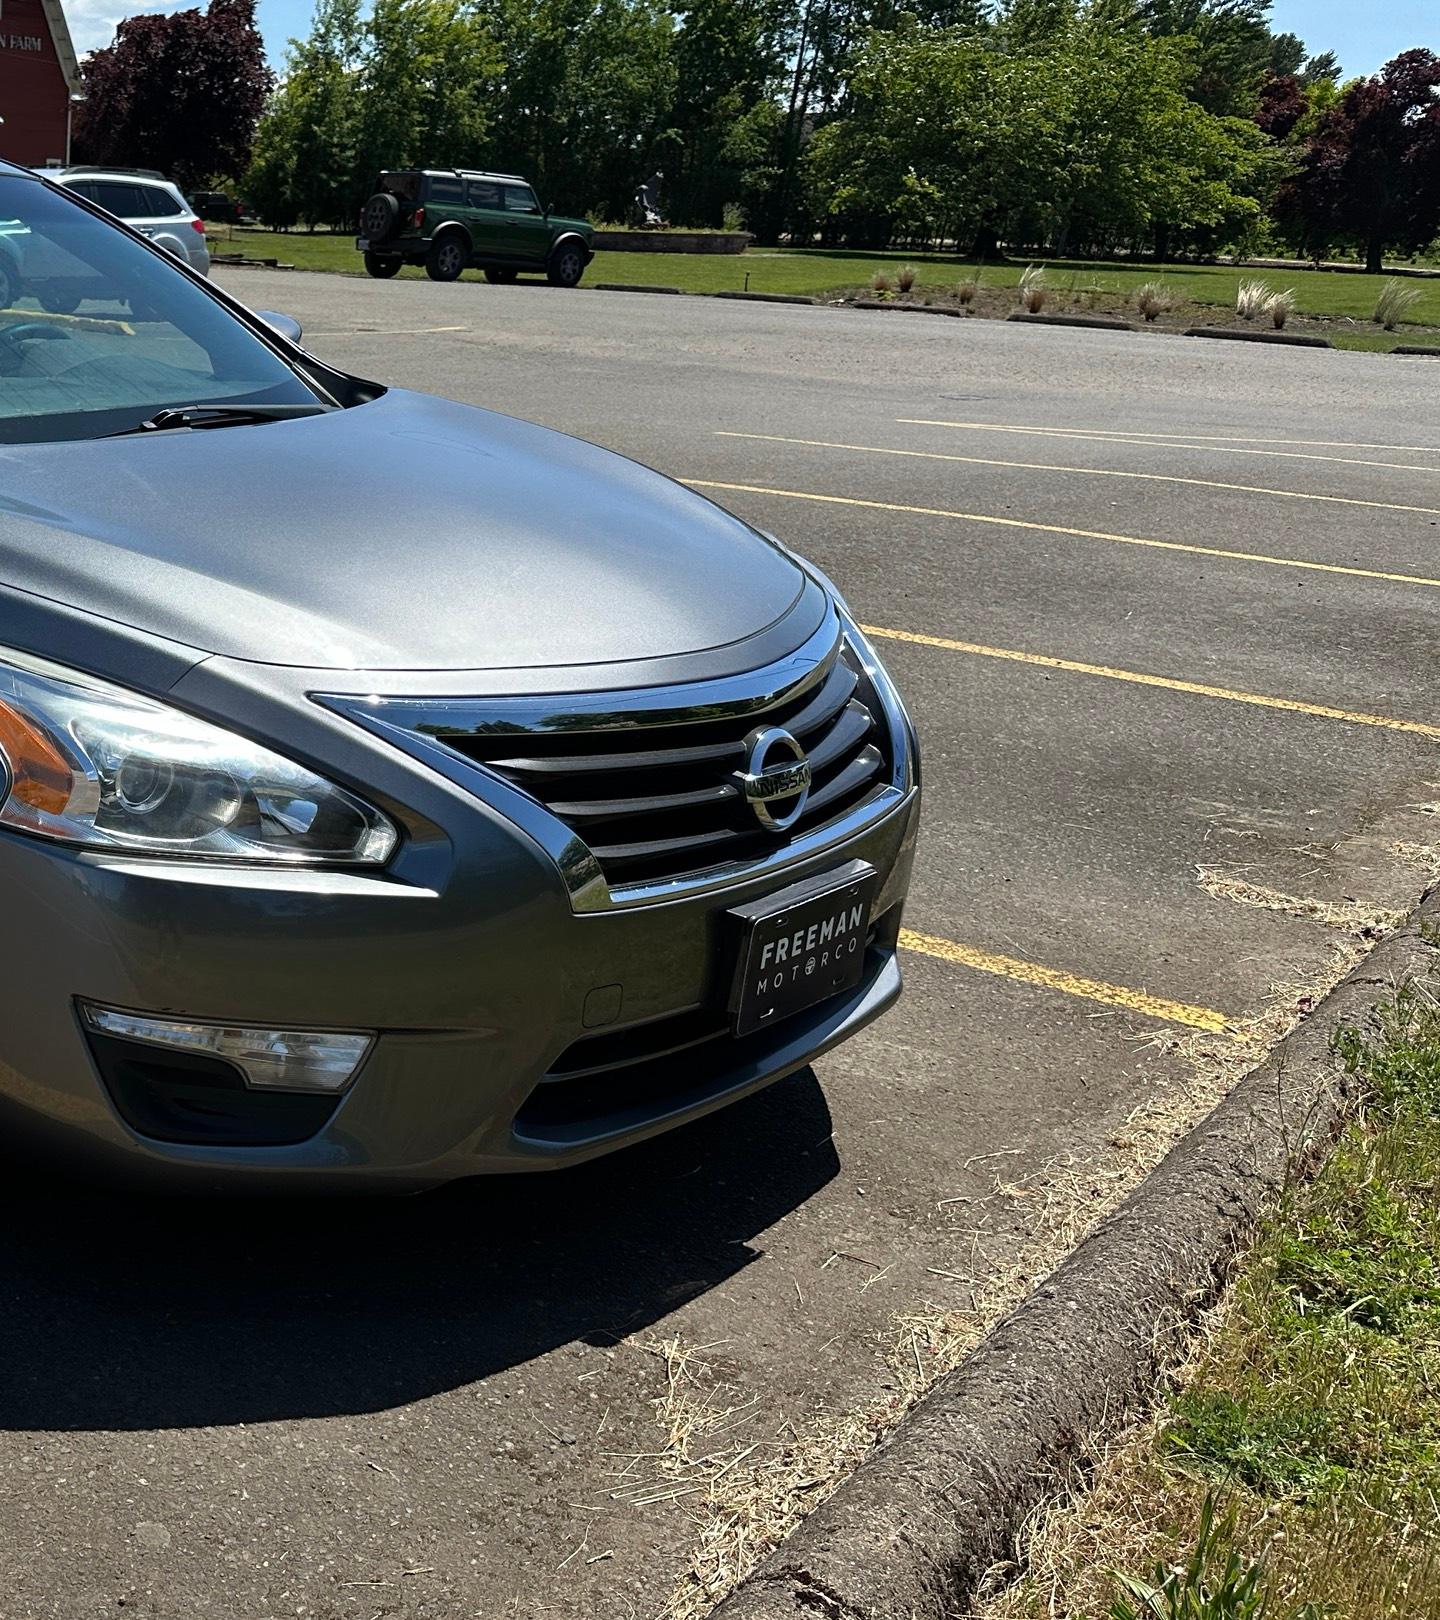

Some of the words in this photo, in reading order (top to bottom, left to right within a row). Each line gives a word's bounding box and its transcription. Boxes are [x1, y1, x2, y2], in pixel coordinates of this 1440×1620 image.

[10, 35, 42, 51] FARM
[760, 903, 863, 970] FREEMAN
[756, 938, 857, 995] MOTORCO
